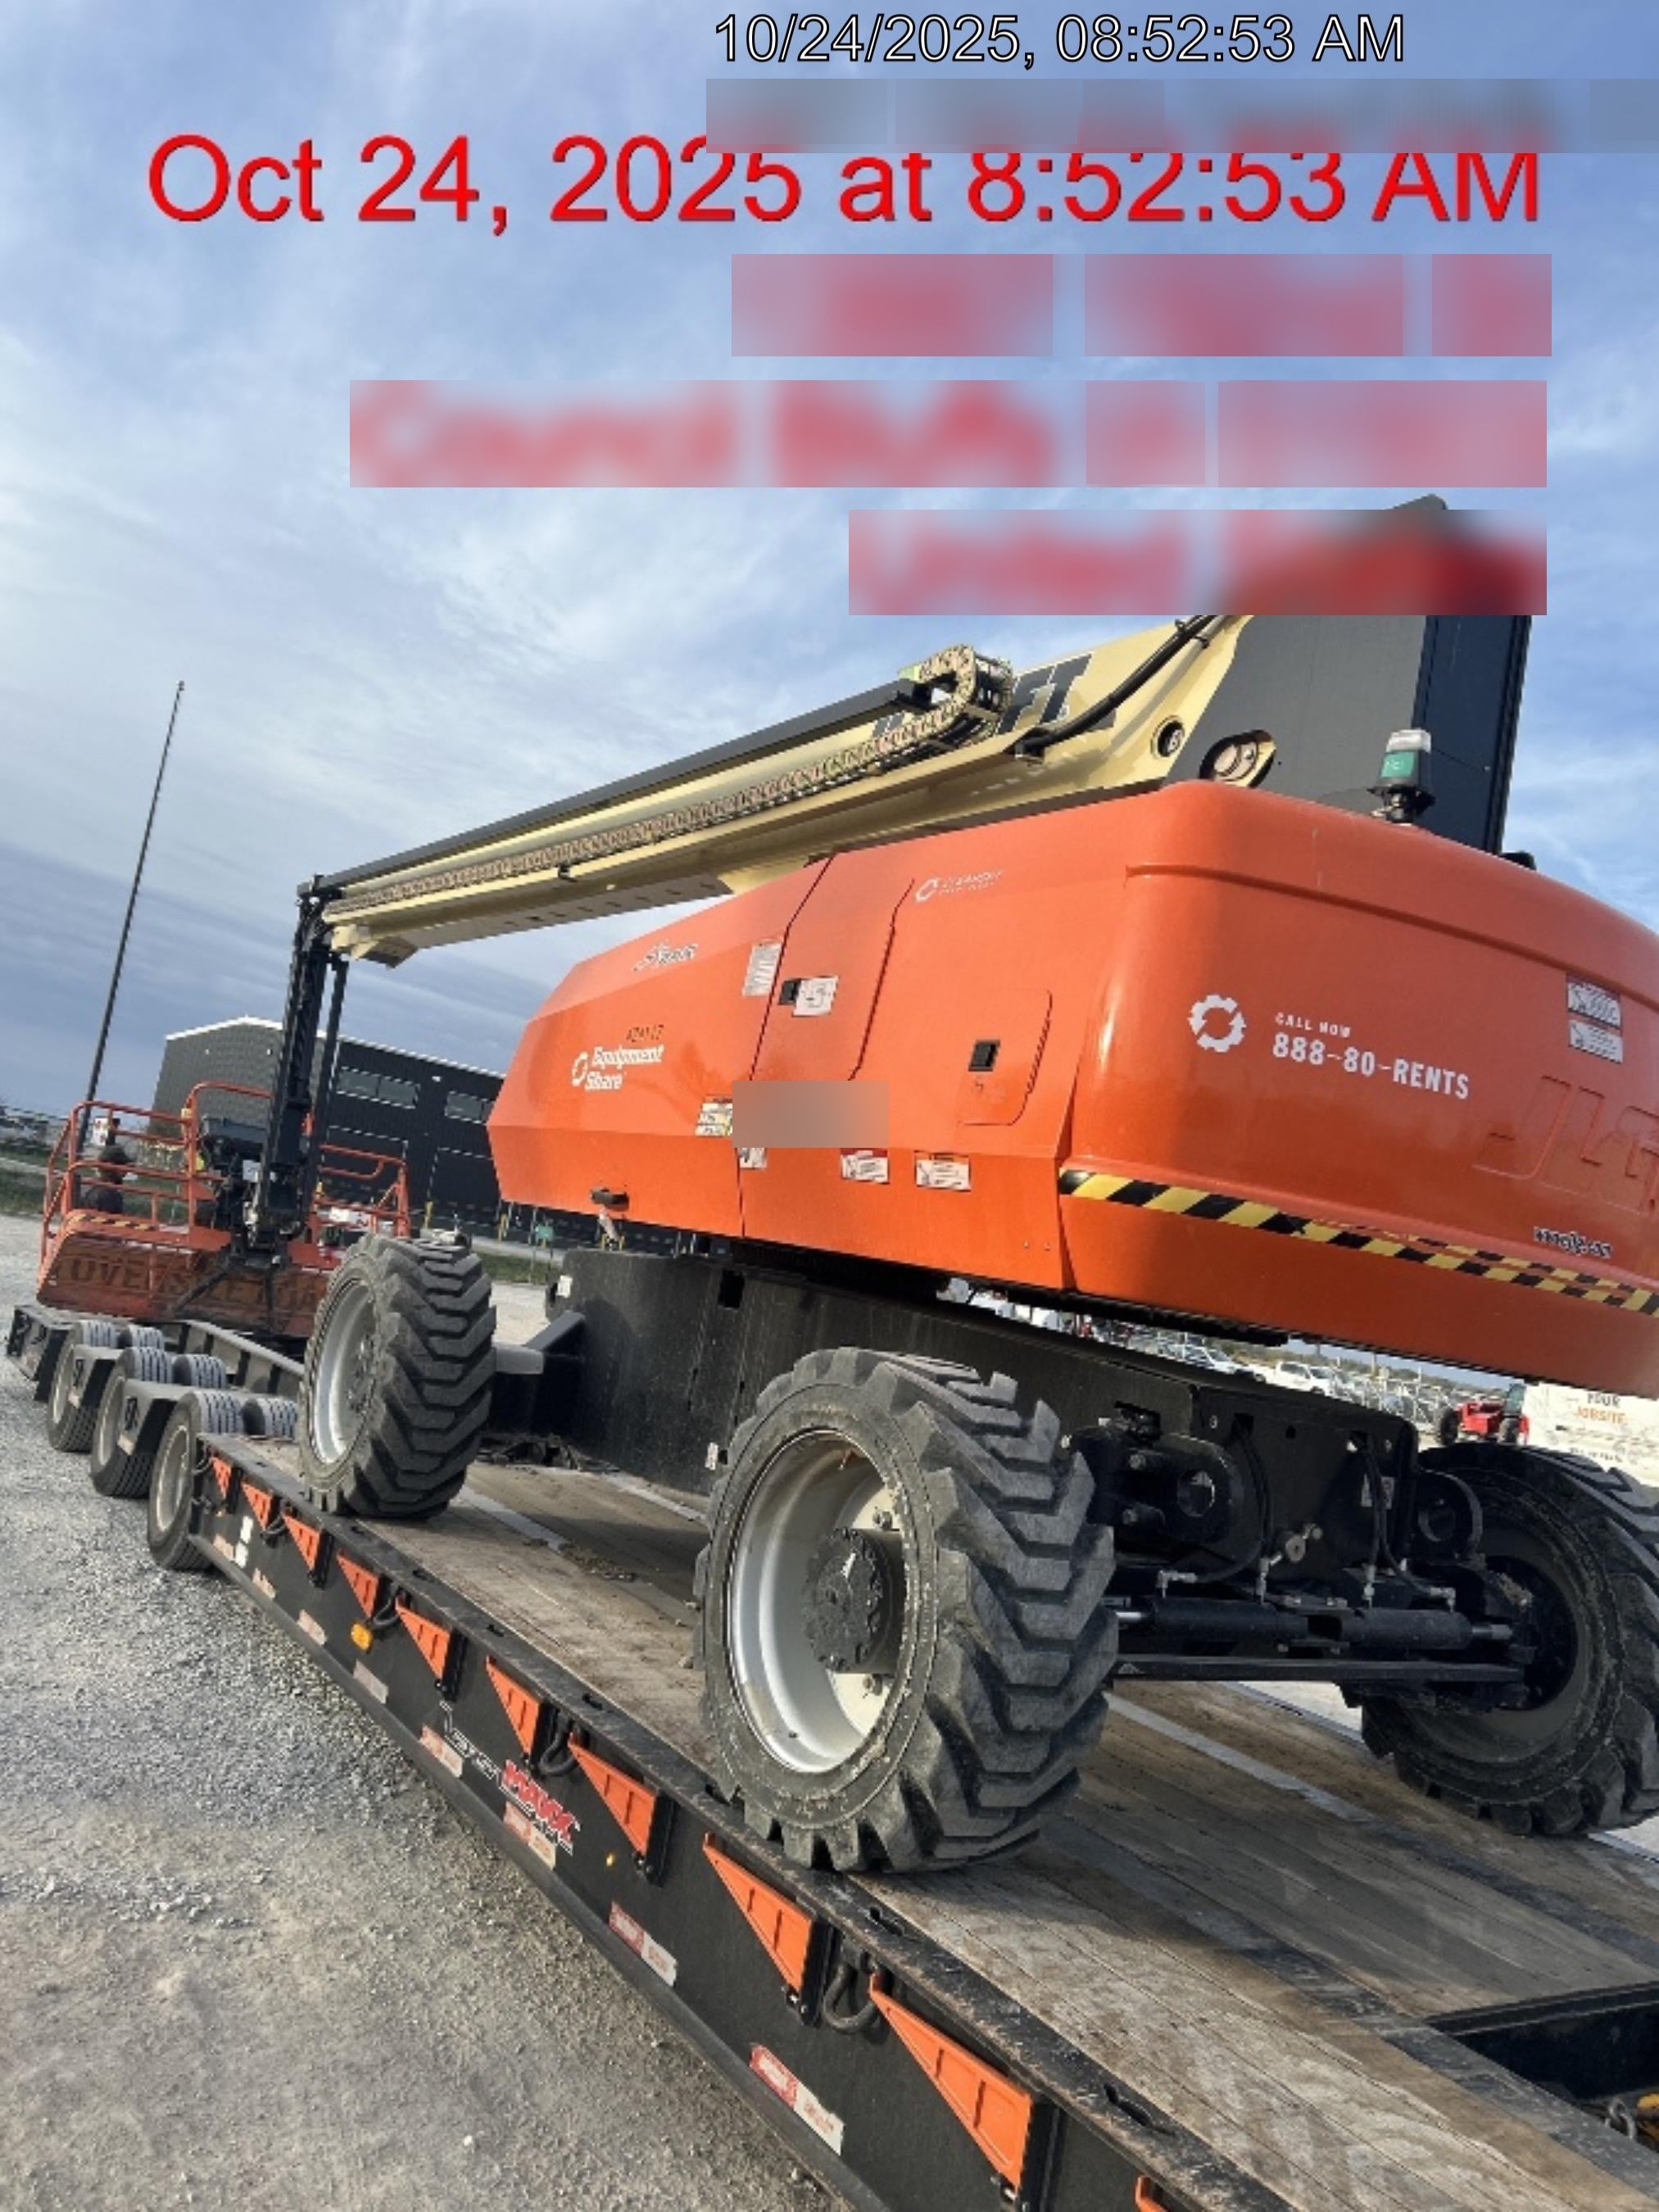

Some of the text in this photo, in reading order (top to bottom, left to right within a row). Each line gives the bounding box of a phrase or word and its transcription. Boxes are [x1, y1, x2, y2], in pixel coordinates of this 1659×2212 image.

[1275, 1012, 1351, 1038] CALL NOW
[592, 1045, 664, 1070] Equipment
[1272, 1032, 1469, 1099] 888-80-RENTS
[585, 1071, 623, 1090] Share
